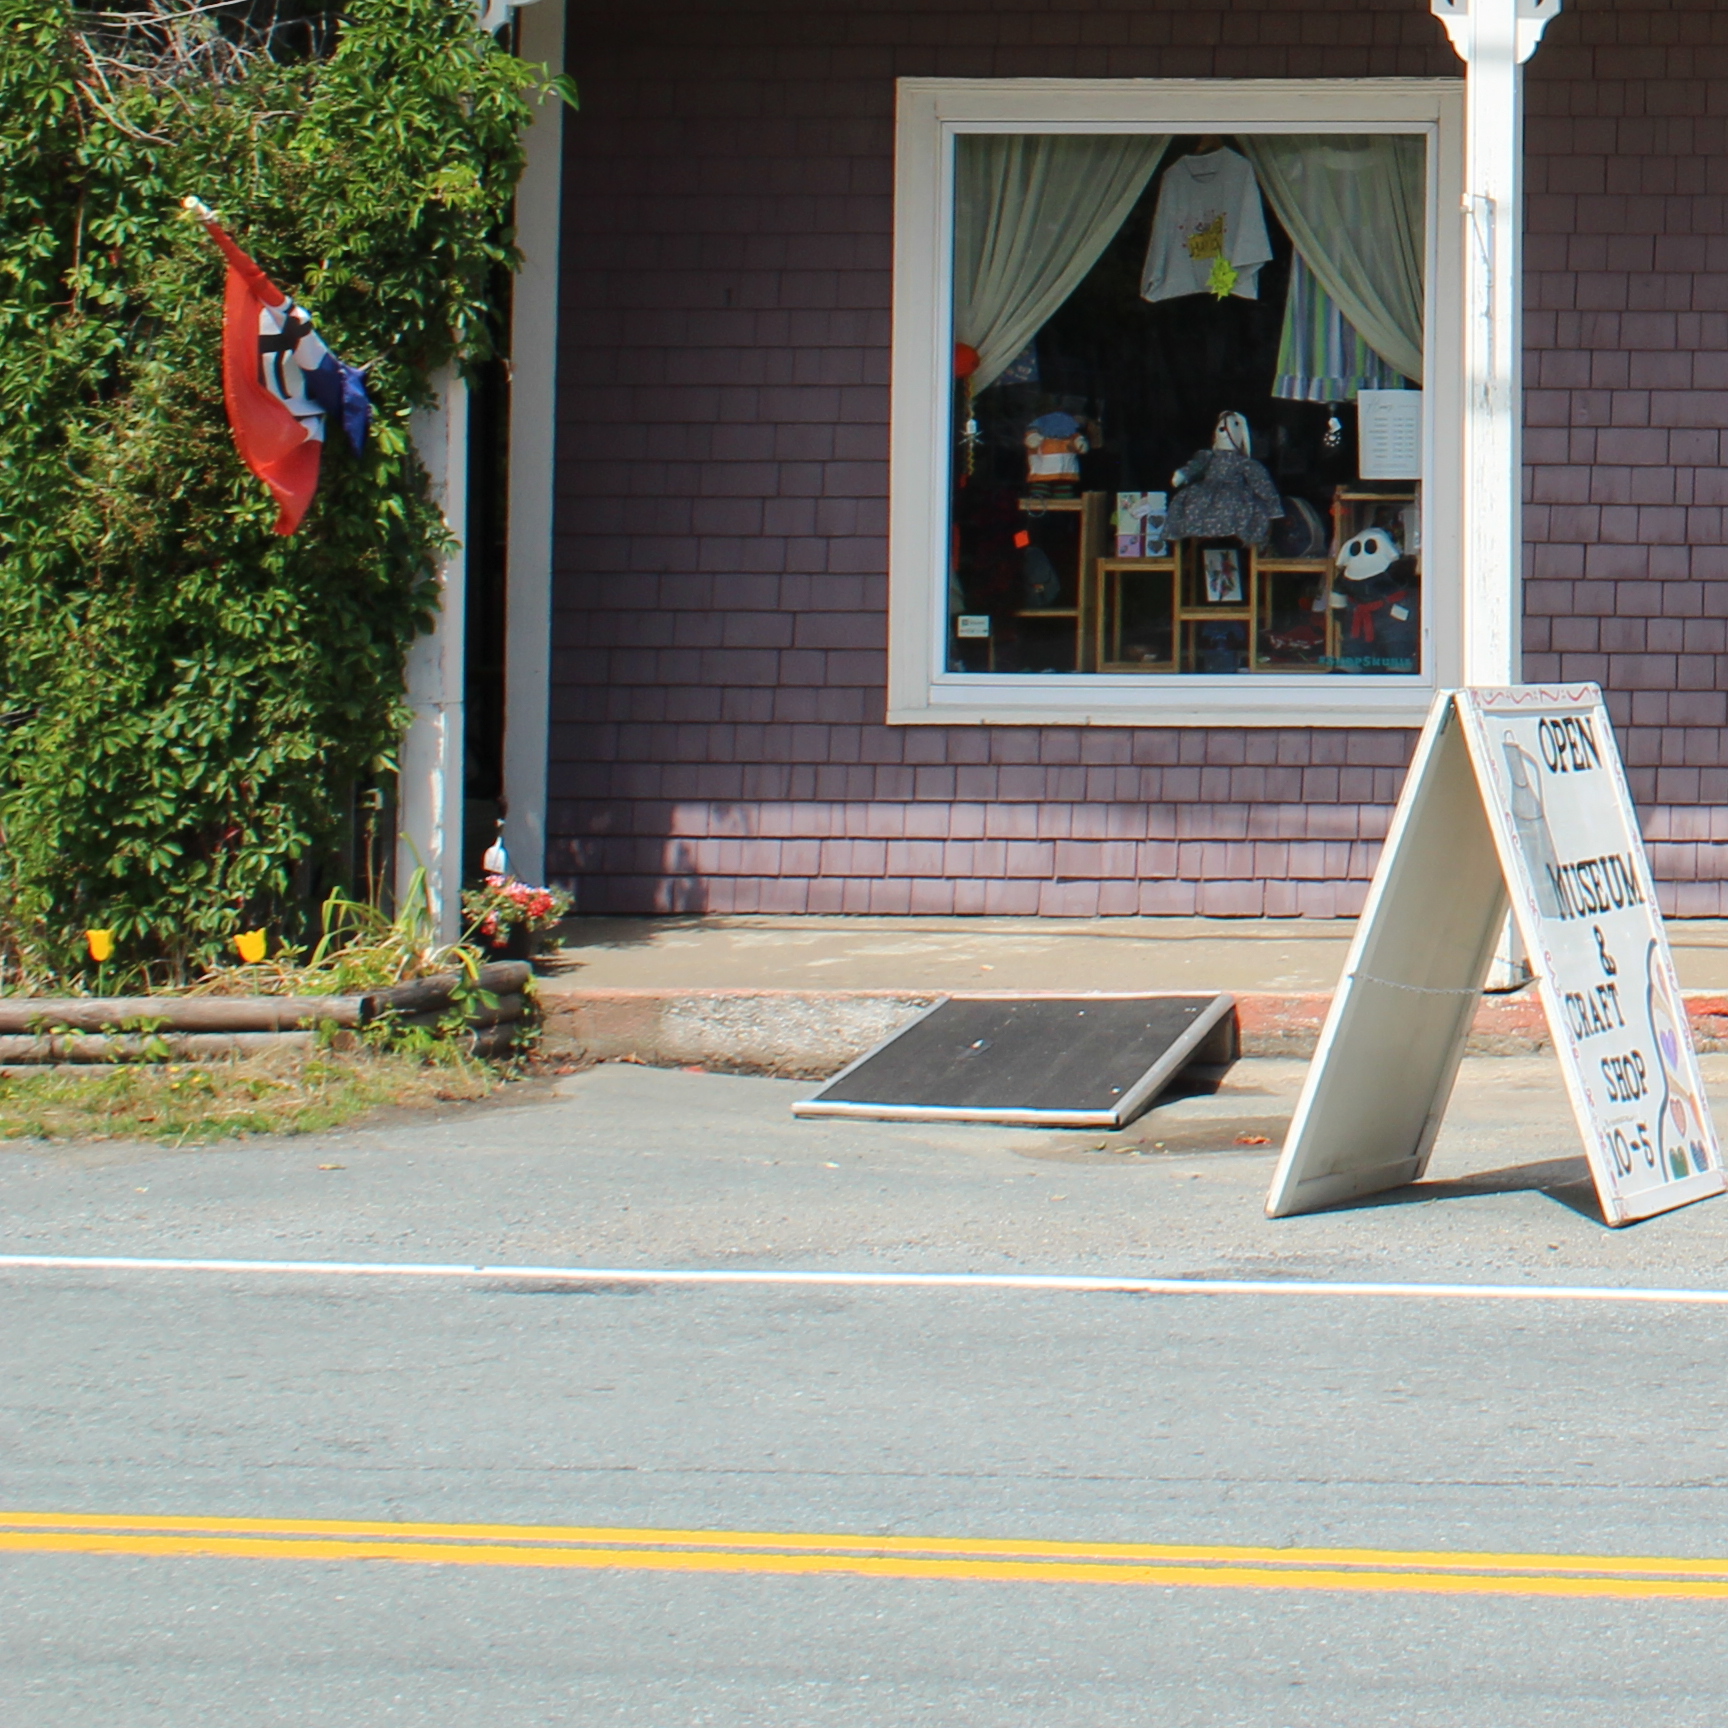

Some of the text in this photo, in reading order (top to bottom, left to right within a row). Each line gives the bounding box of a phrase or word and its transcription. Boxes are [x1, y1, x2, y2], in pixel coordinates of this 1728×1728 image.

[1538, 716, 1602, 774] OPEN
[1546, 852, 1646, 921] MUSEUM
[1594, 925, 1618, 976] &
[1565, 982, 1627, 1042] CRAFT
[1600, 1050, 1648, 1103] SHOP
[1608, 1124, 1656, 1178] 10-5
